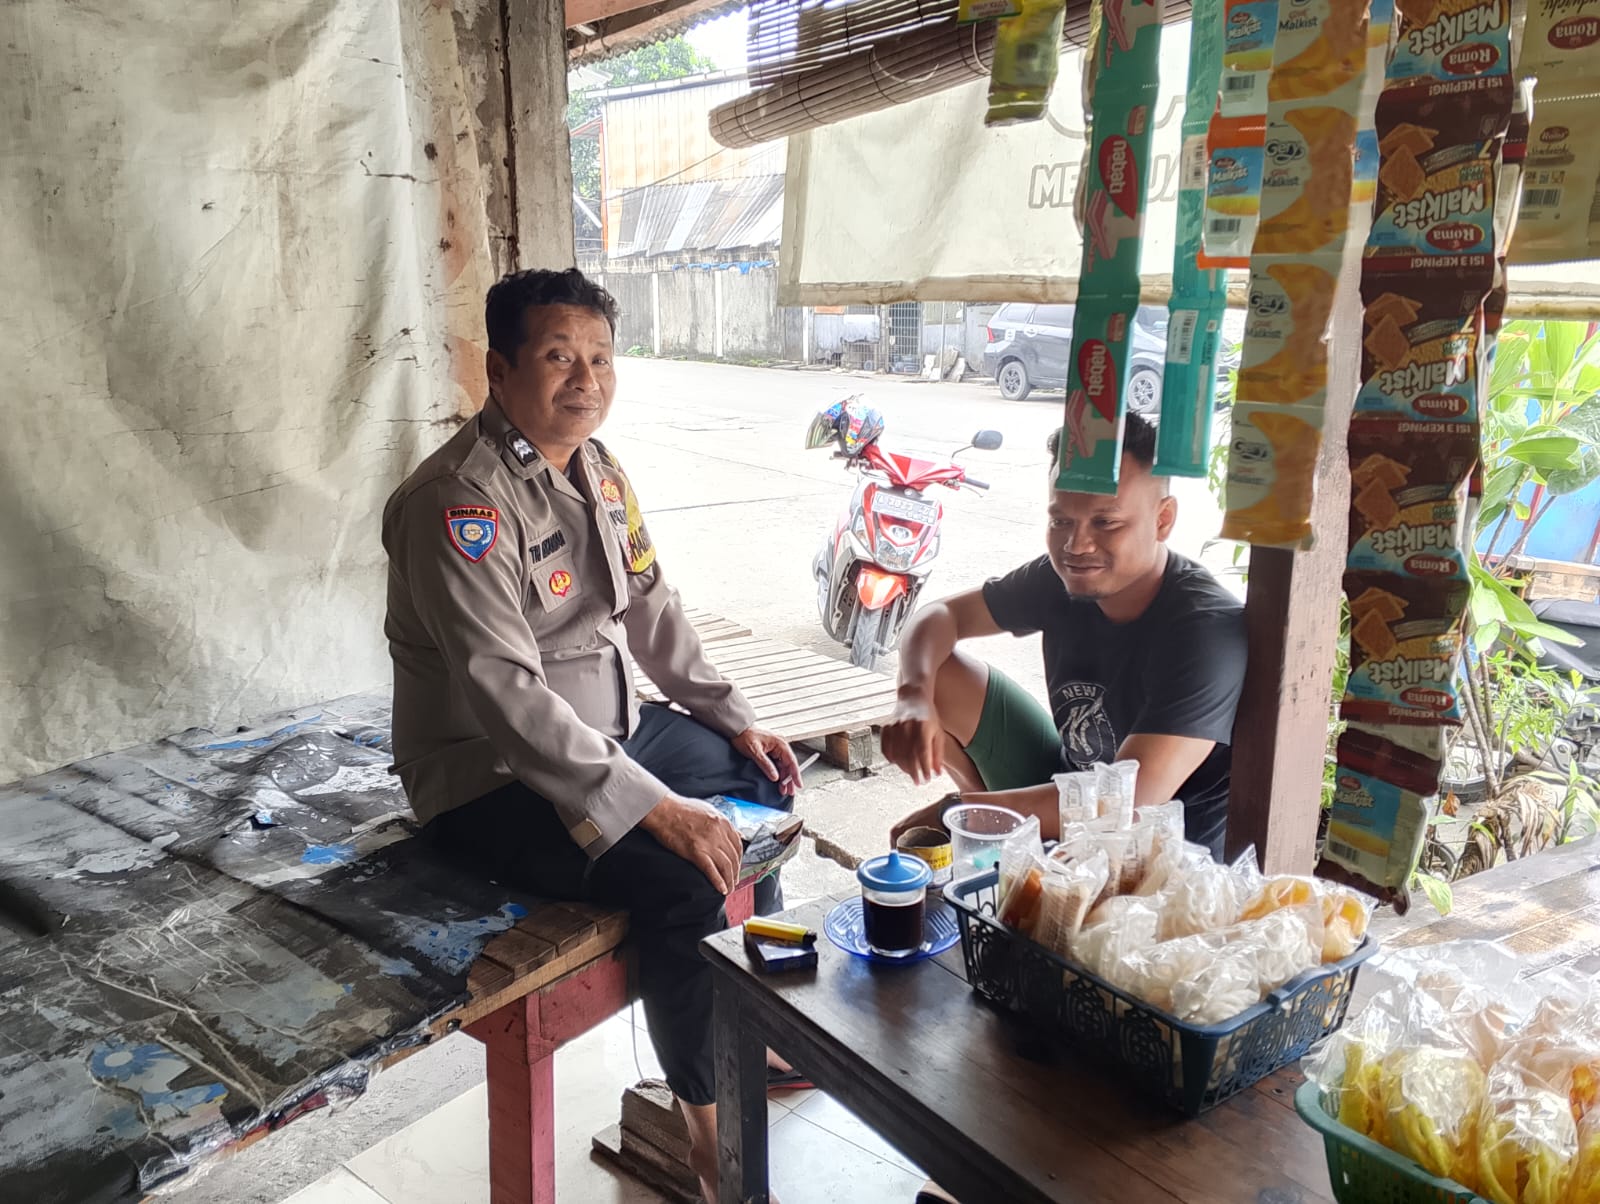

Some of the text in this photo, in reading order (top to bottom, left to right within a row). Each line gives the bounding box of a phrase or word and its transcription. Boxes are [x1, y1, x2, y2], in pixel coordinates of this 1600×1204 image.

[1279, 16, 1318, 31] Malkist
[1409, 1, 1502, 55] Malkist
[1556, 22, 1598, 38] Roma
[1449, 48, 1490, 65] Roma
[1428, 78, 1503, 96] ISI 3 KEPING!
[1110, 140, 1127, 193] nabati
[1394, 184, 1485, 228] Malkist
[1433, 228, 1475, 241] Roma
[1410, 255, 1485, 268] ISI 3 KEPING!
[1088, 345, 1106, 396] nabati
[1380, 356, 1467, 398] Malkist
[1419, 399, 1460, 412] Roma
[1397, 423, 1471, 433] ISI 3 KEPING!
[450, 508, 493, 518] BINMAS
[1373, 523, 1456, 556] Malkist
[1410, 559, 1450, 573] Roma
[1369, 656, 1456, 689] Malkist
[1062, 685, 1097, 700] NEW
[1406, 693, 1447, 706] Roma
